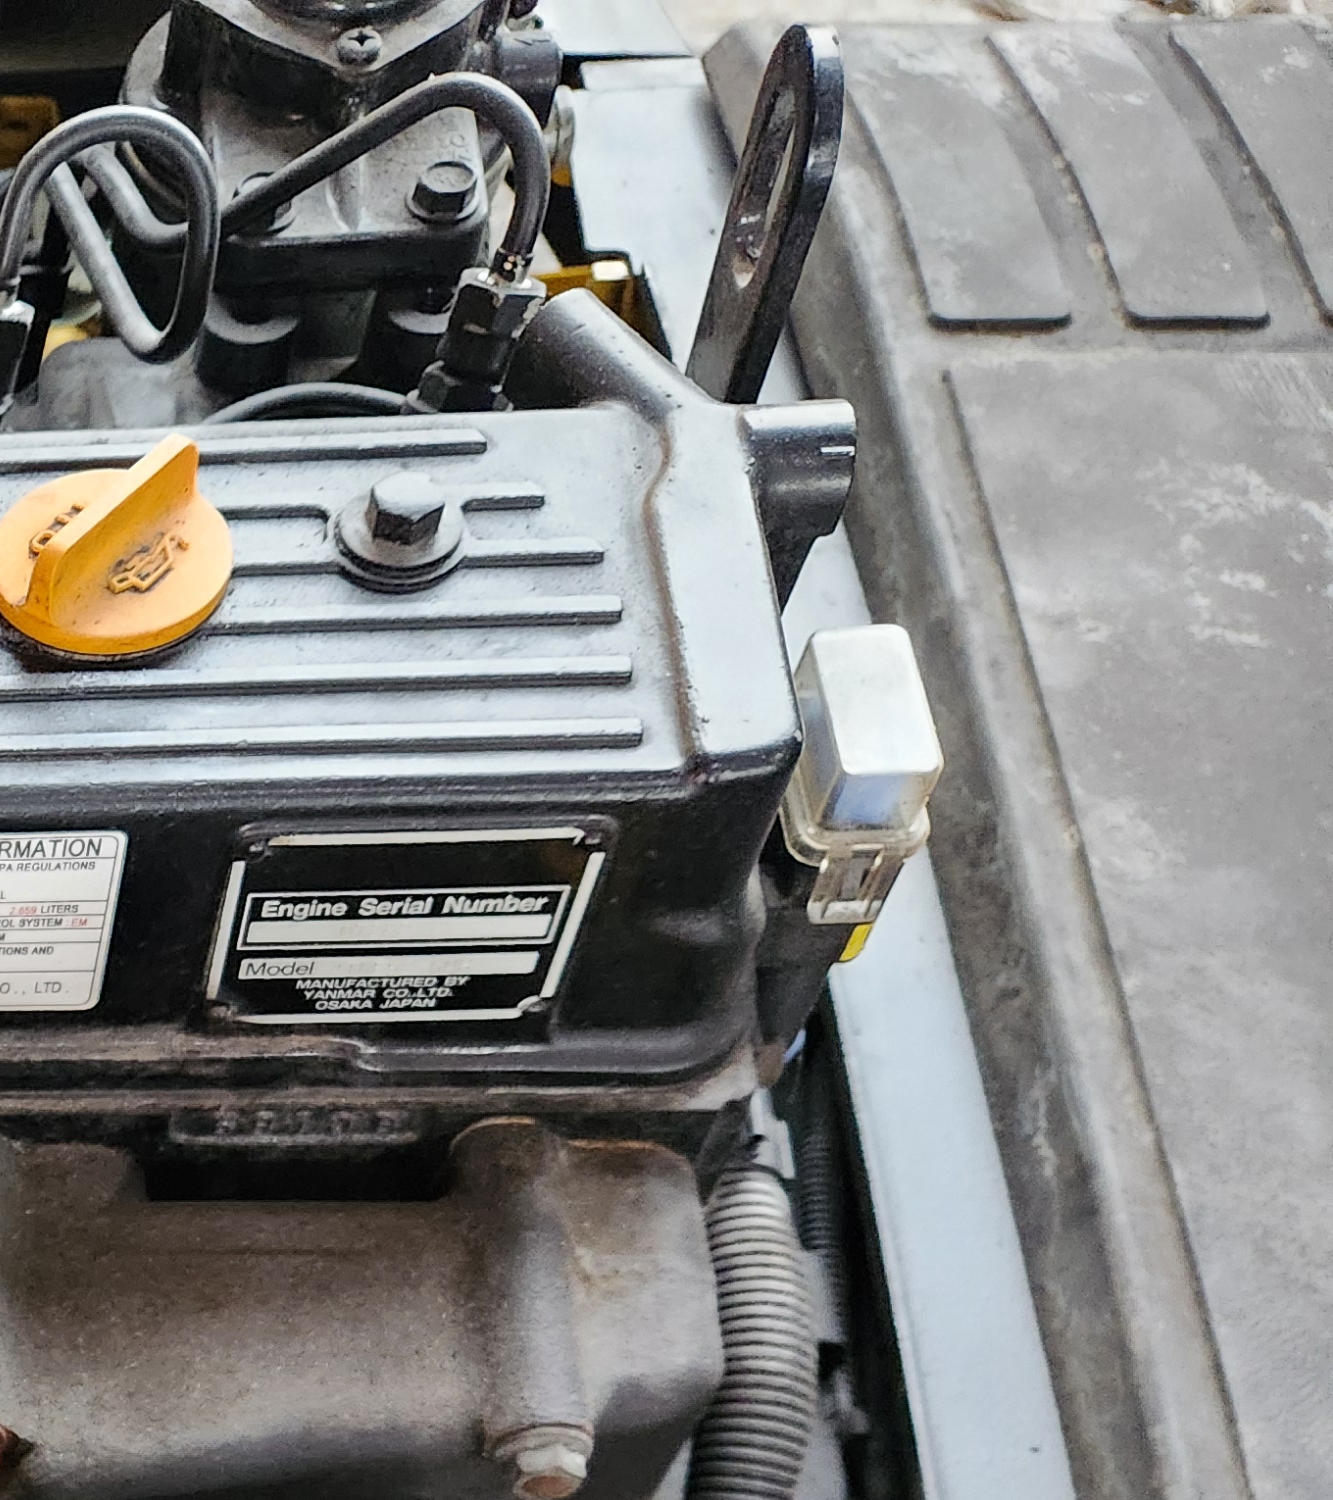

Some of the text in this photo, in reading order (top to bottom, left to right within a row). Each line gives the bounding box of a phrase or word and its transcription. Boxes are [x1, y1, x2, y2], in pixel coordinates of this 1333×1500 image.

[16, 862, 96, 871] REGULATIONS
[41, 905, 78, 914] LITERS
[261, 894, 549, 921] Engine Serial Number
[19, 918, 62, 927] SYSTEM
[71, 918, 87, 926] EM
[32, 946, 54, 955] AND
[246, 962, 315, 976] Model
[296, 976, 469, 990] MANUFACTURED BY
[303, 988, 376, 1000] YANMAR
[315, 998, 437, 1010] OSAKA JAPAN
